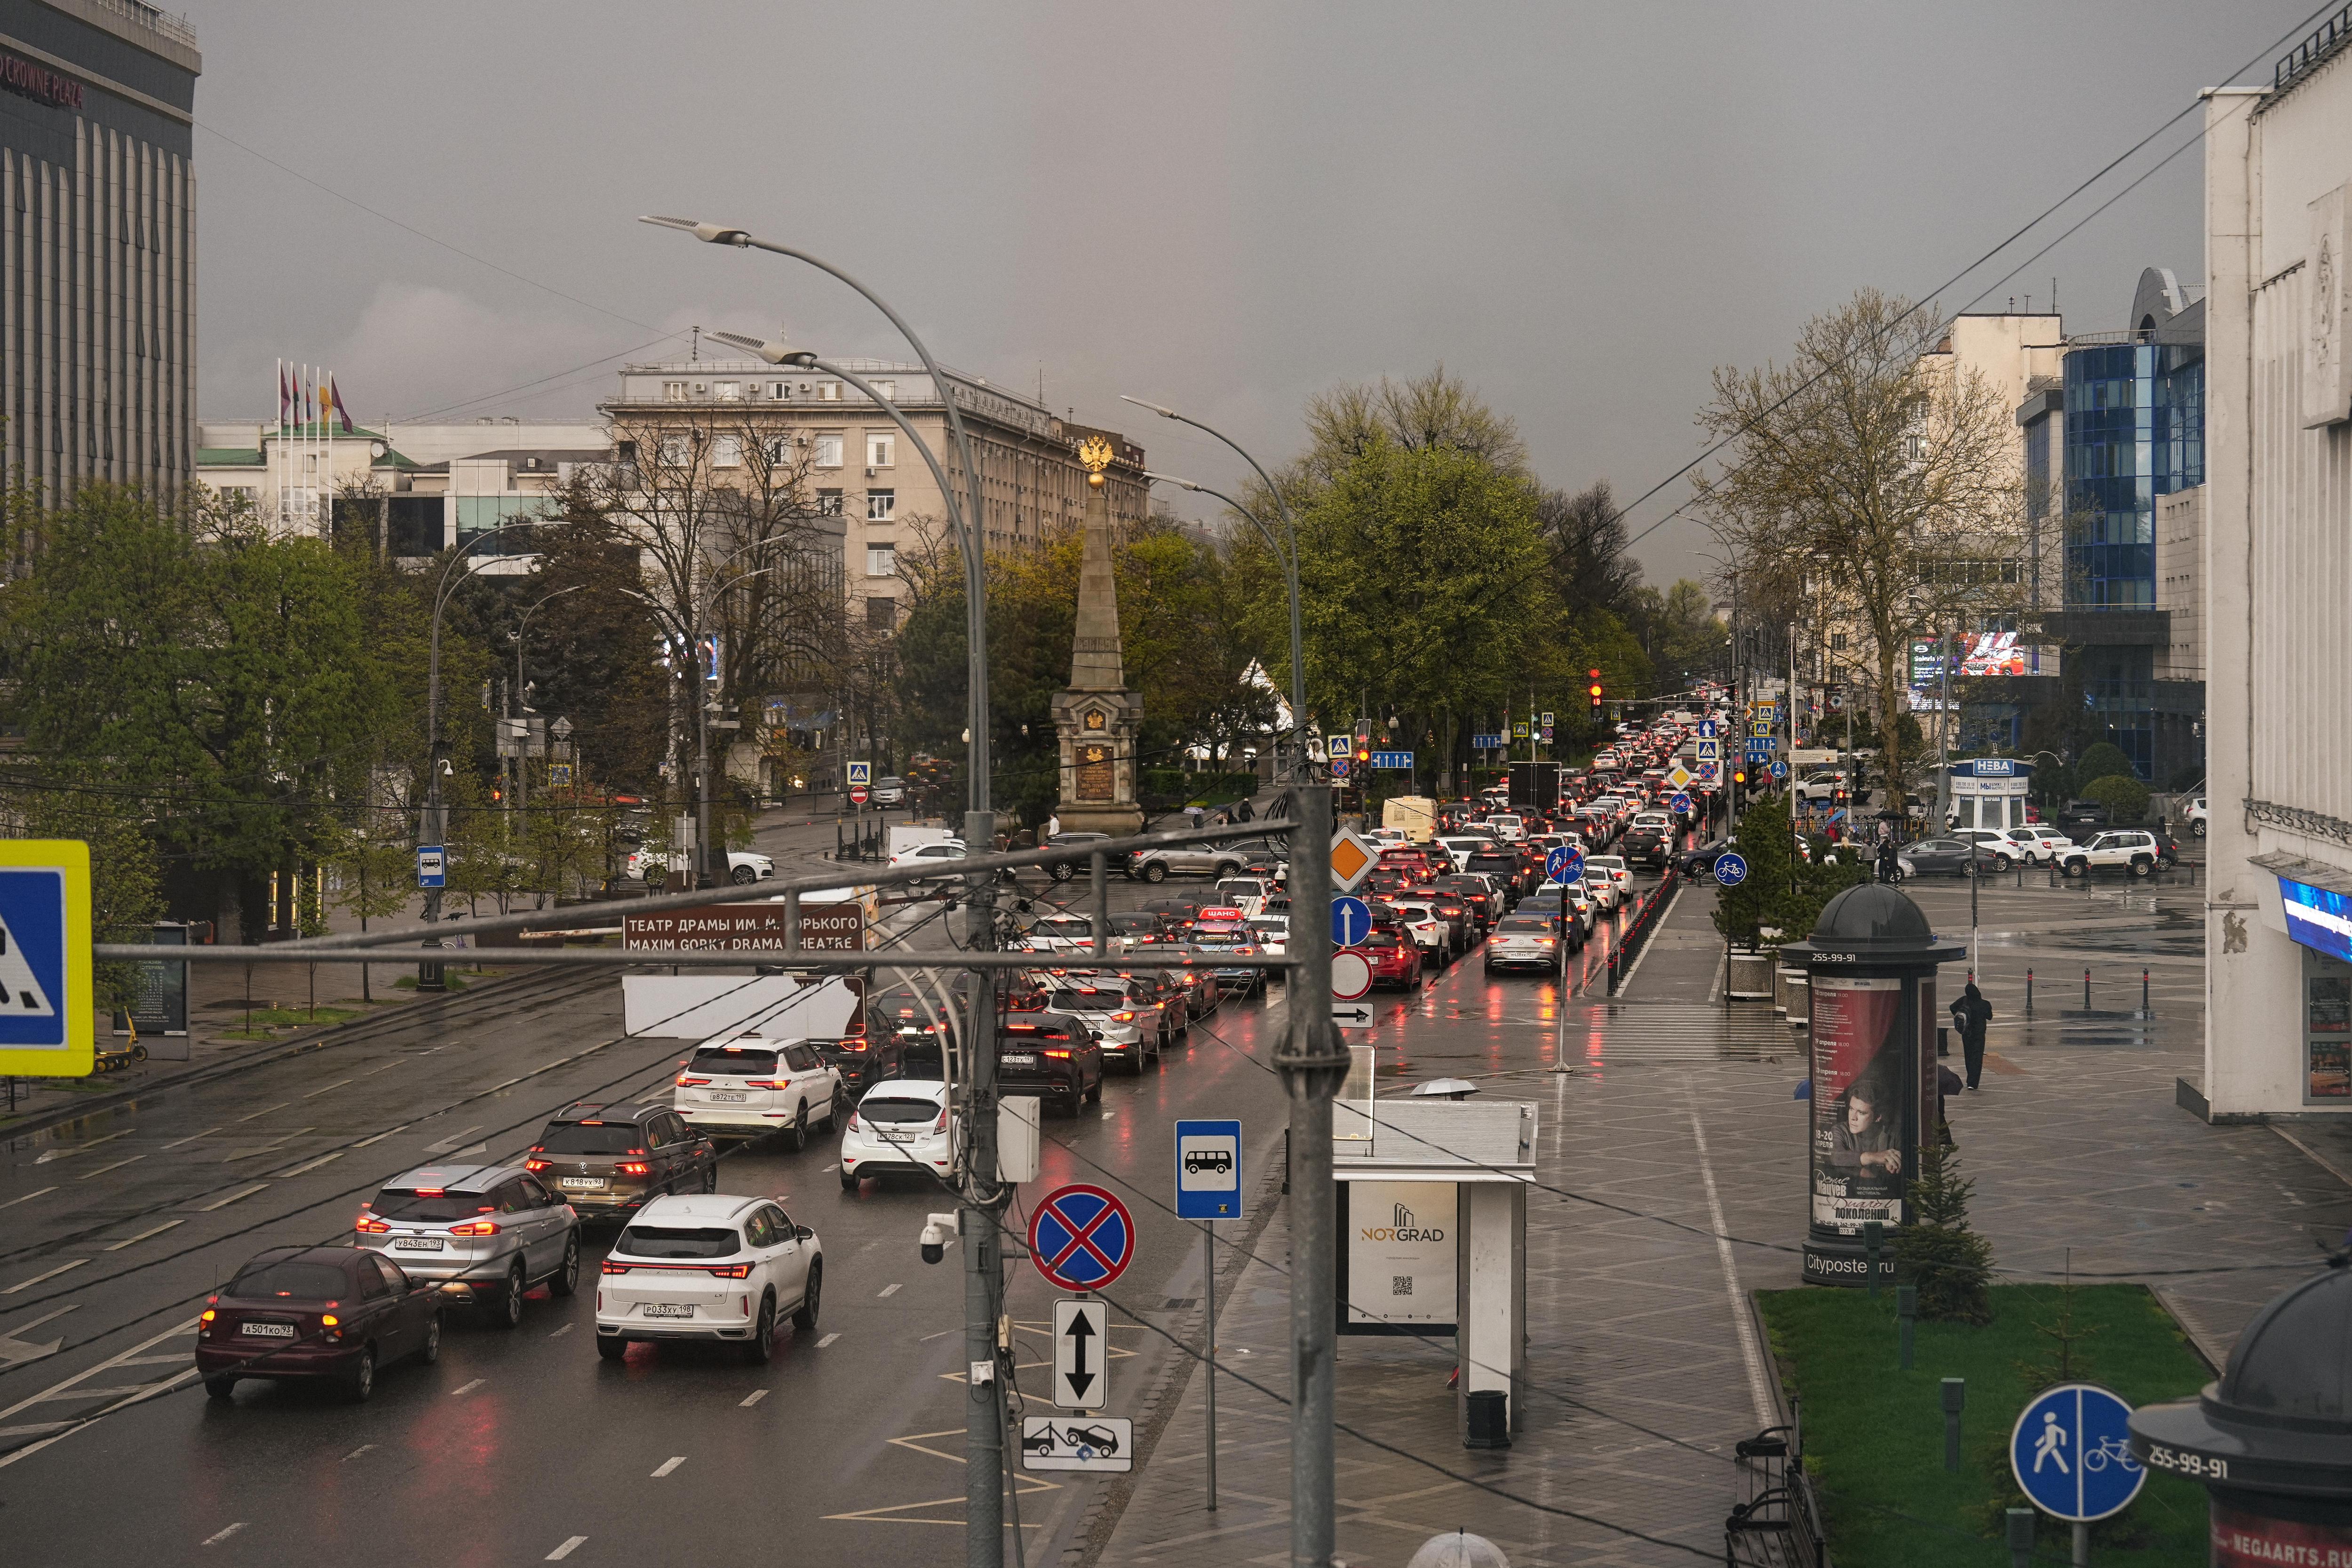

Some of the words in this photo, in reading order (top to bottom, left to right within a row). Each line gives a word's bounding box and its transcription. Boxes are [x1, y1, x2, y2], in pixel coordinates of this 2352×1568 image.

[6, 56, 48, 97] CROWNE
[53, 74, 83, 109] PLAZA
[1978, 761, 2010, 771] НЕВА
[629, 920, 673, 931] ТЕАТР
[678, 919, 730, 933] ДРАМЫ
[736, 919, 760, 931] ИМ.
[765, 919, 780, 930] М.
[799, 918, 858, 930] РЬКОГО
[630, 939, 675, 950] MAXIM
[681, 938, 726, 950] GORKY
[732, 938, 783, 950] DRAMA
[800, 937, 852, 949] HEATRE
[1812, 953, 1855, 962] 255-99-91
[1815, 1130, 1833, 1141] 18-20
[1815, 1139, 1833, 1148] АПРЕЛЯ
[1817, 1180, 1847, 1197] Мацуев
[1362, 1228, 1444, 1242] NORGRAD
[1808, 1254, 1894, 1274] Cityposteru
[246, 1325, 280, 1334] А501КО
[2149, 1443, 2228, 1480] 255-99-91
